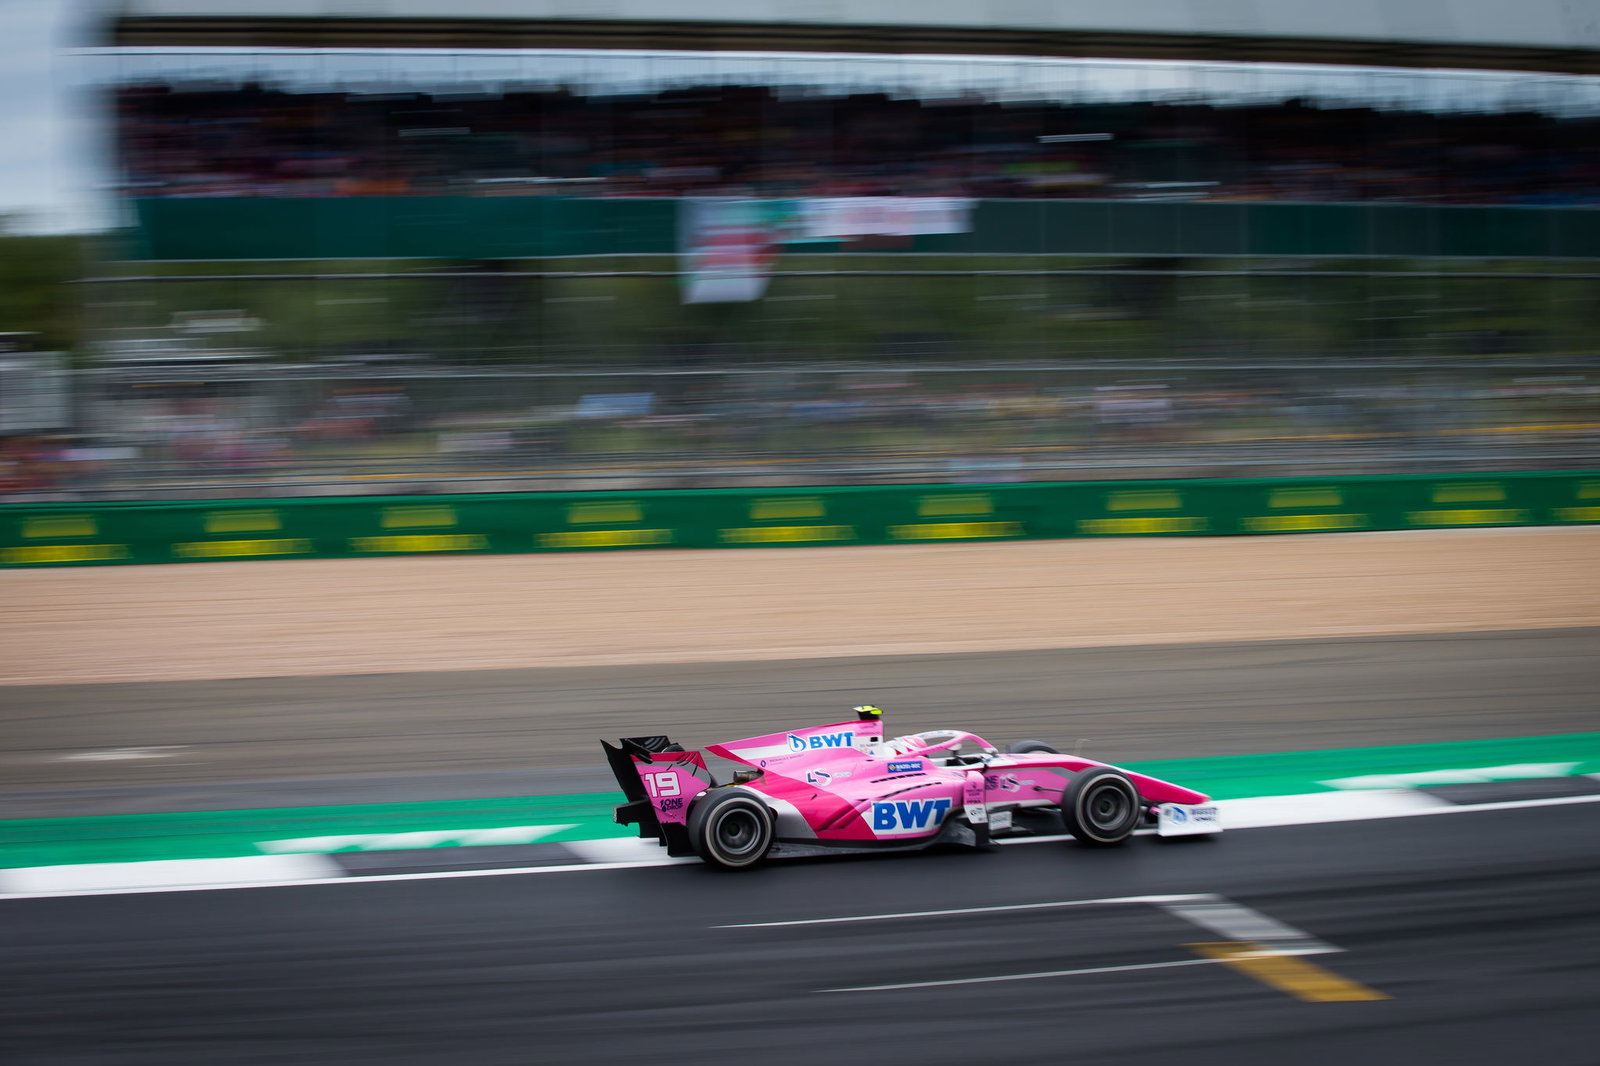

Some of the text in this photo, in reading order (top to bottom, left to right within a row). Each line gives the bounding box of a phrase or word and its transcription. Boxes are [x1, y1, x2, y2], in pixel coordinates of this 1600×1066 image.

[809, 731, 854, 749] BWT
[644, 771, 682, 798] 19
[873, 798, 952, 831] BWT
